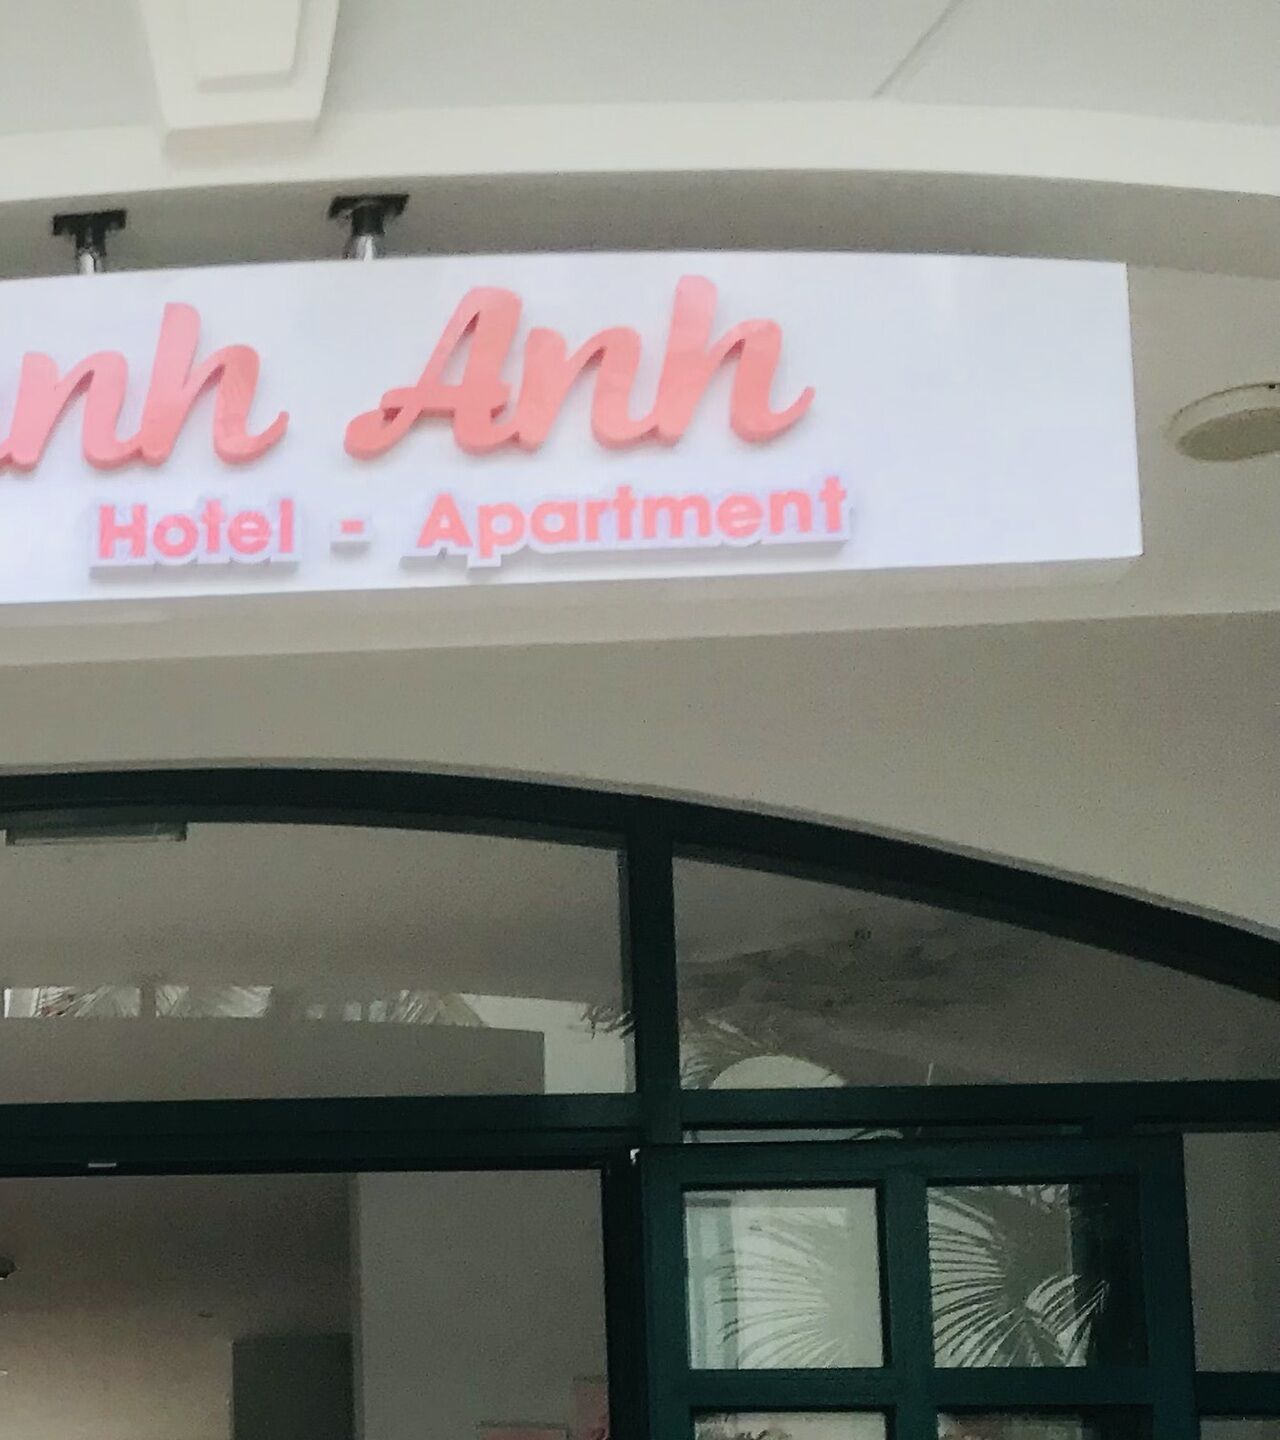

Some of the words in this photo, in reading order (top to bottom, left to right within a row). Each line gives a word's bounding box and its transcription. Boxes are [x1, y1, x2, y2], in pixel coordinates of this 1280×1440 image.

[343, 274, 816, 461] Anh
[97, 497, 295, 560] Hotel
[416, 475, 849, 564] Apartment
